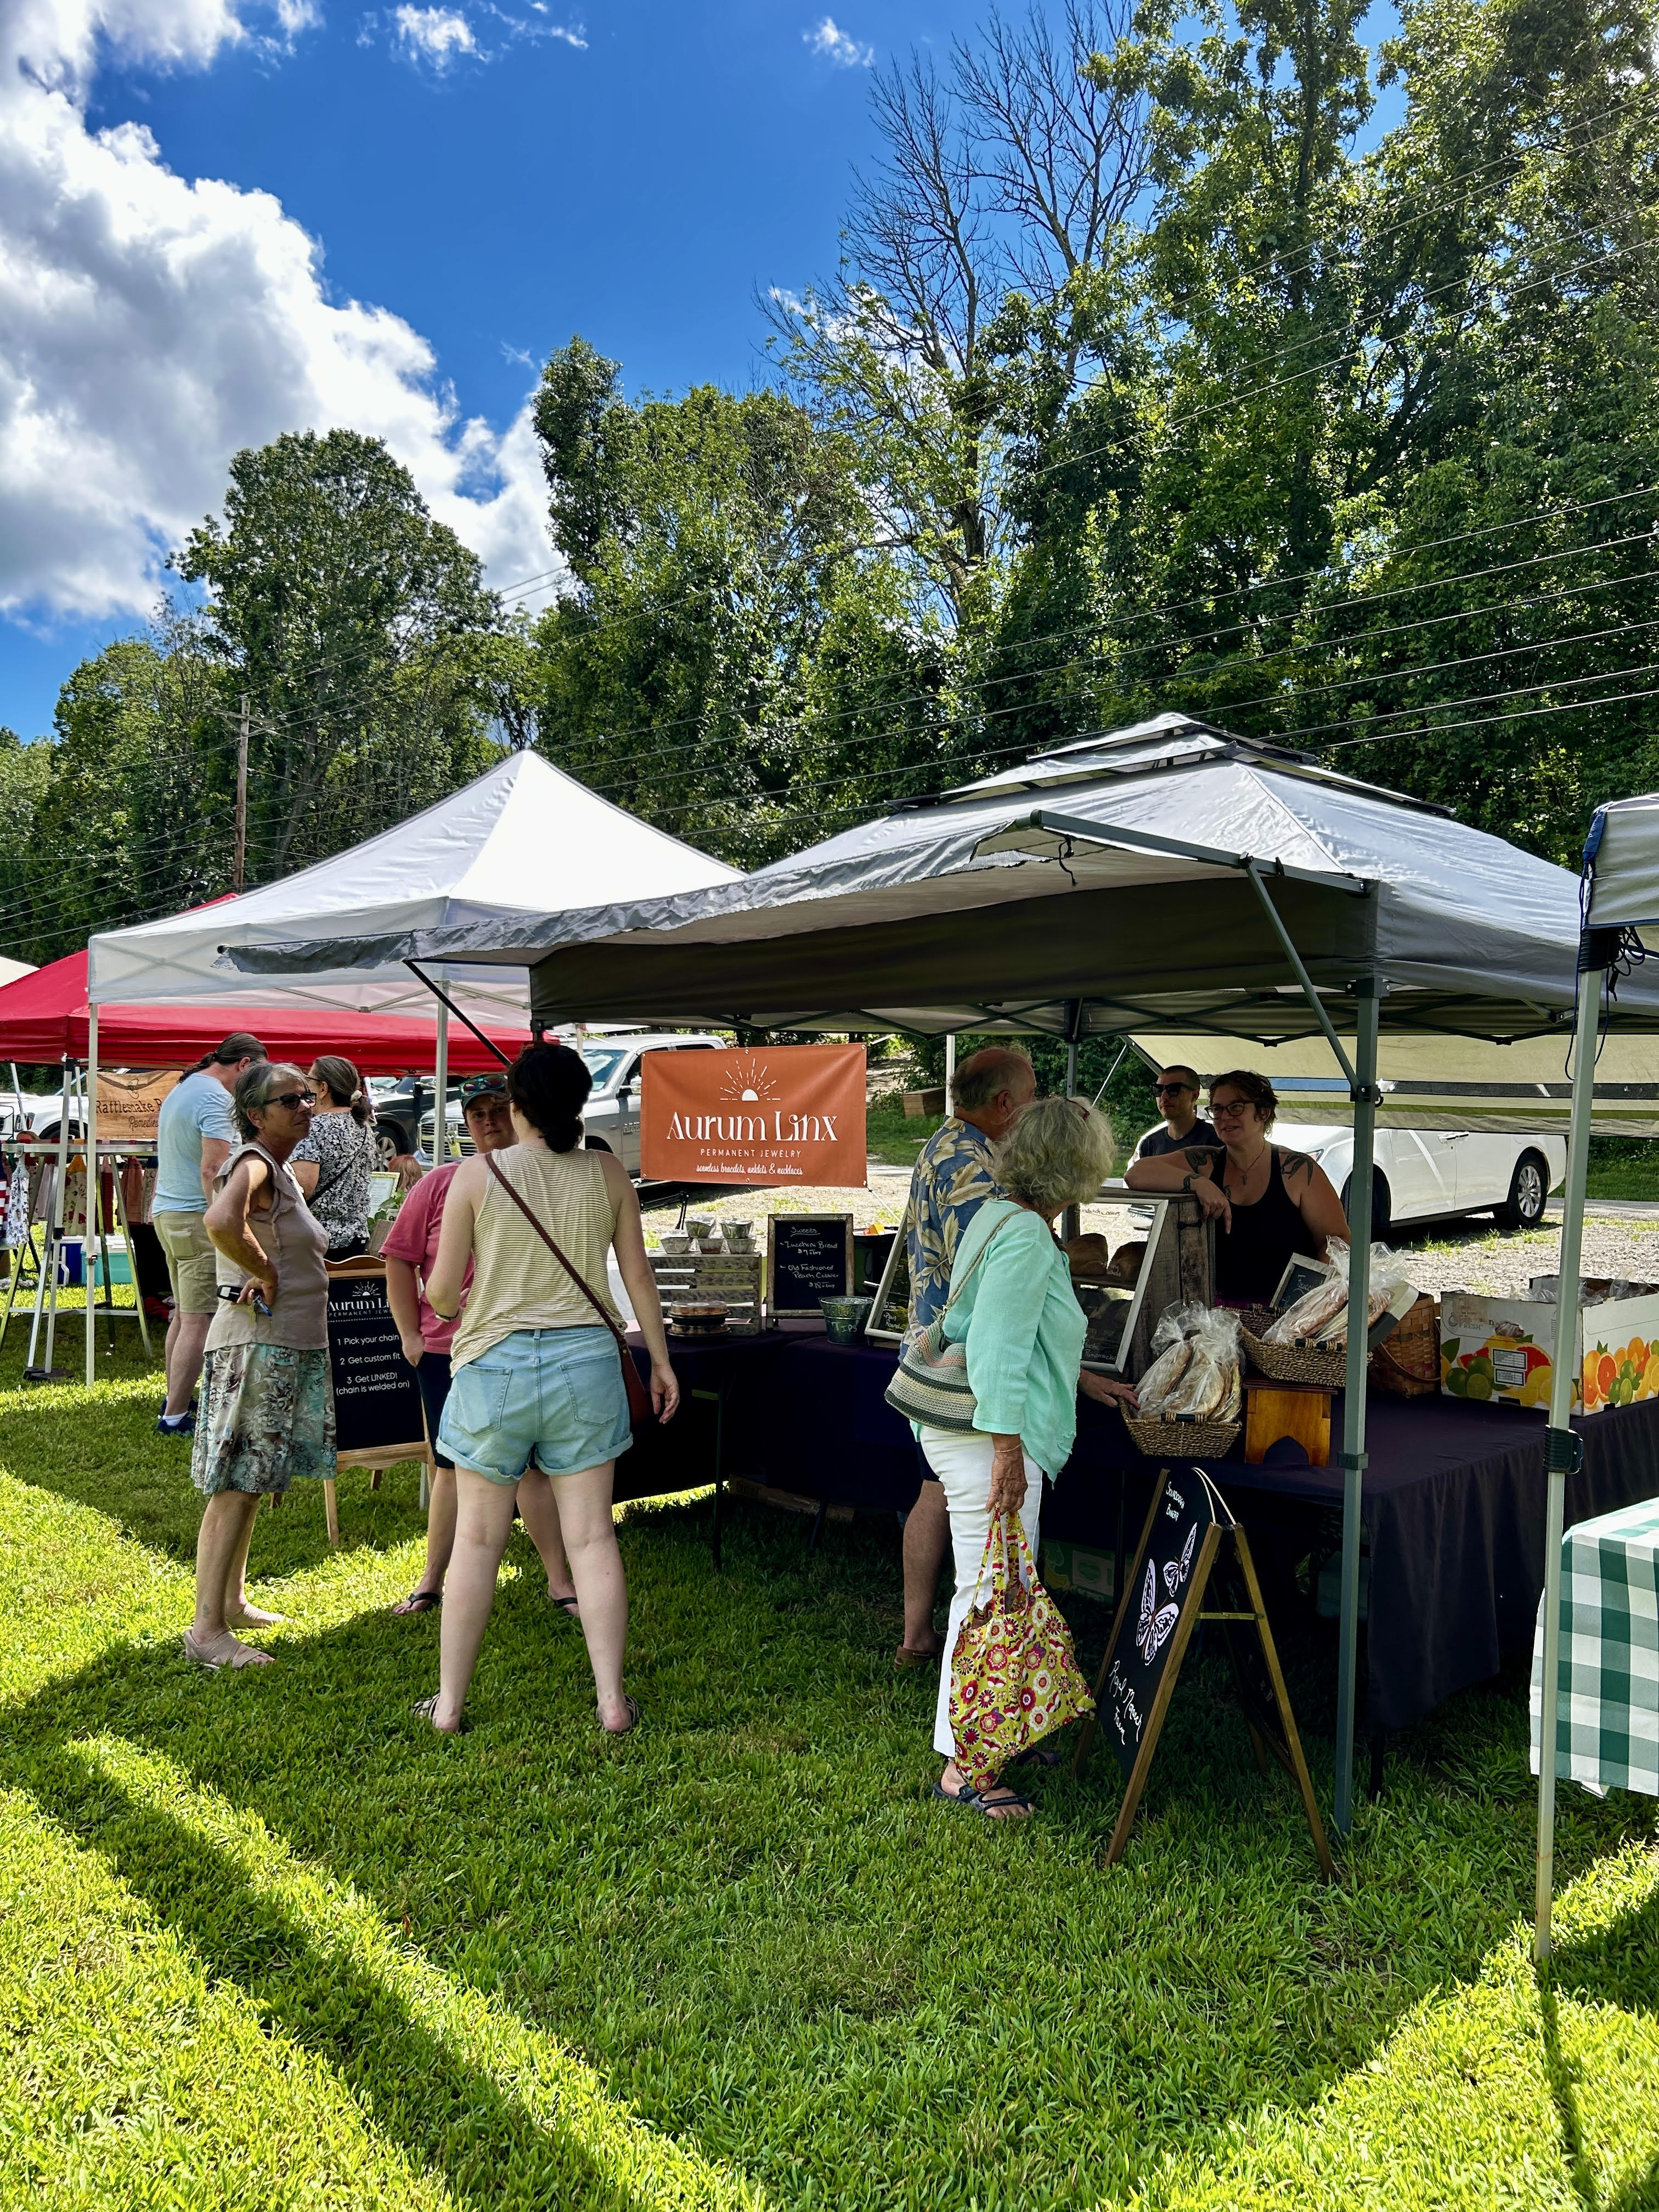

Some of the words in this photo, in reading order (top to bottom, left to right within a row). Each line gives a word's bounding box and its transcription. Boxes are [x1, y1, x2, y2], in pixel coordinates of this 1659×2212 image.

[97, 1100, 155, 1114] Rattlesnake
[667, 1111, 768, 1141] Aurum
[775, 1111, 838, 1141] Linx
[700, 1148, 755, 1157] PERMANENT
[760, 1149, 802, 1158] JEWELRY
[769, 1163, 776, 1174] &
[328, 1299, 375, 1312] Aurum
[378, 1297, 390, 1308] Li
[361, 1336, 377, 1345] your
[379, 1334, 399, 1342] chain
[348, 1356, 363, 1364] Get
[364, 1353, 392, 1363] custom
[336, 1386, 360, 1396] (chain
[368, 1382, 396, 1391] welded
[398, 1380, 410, 1388] on)
